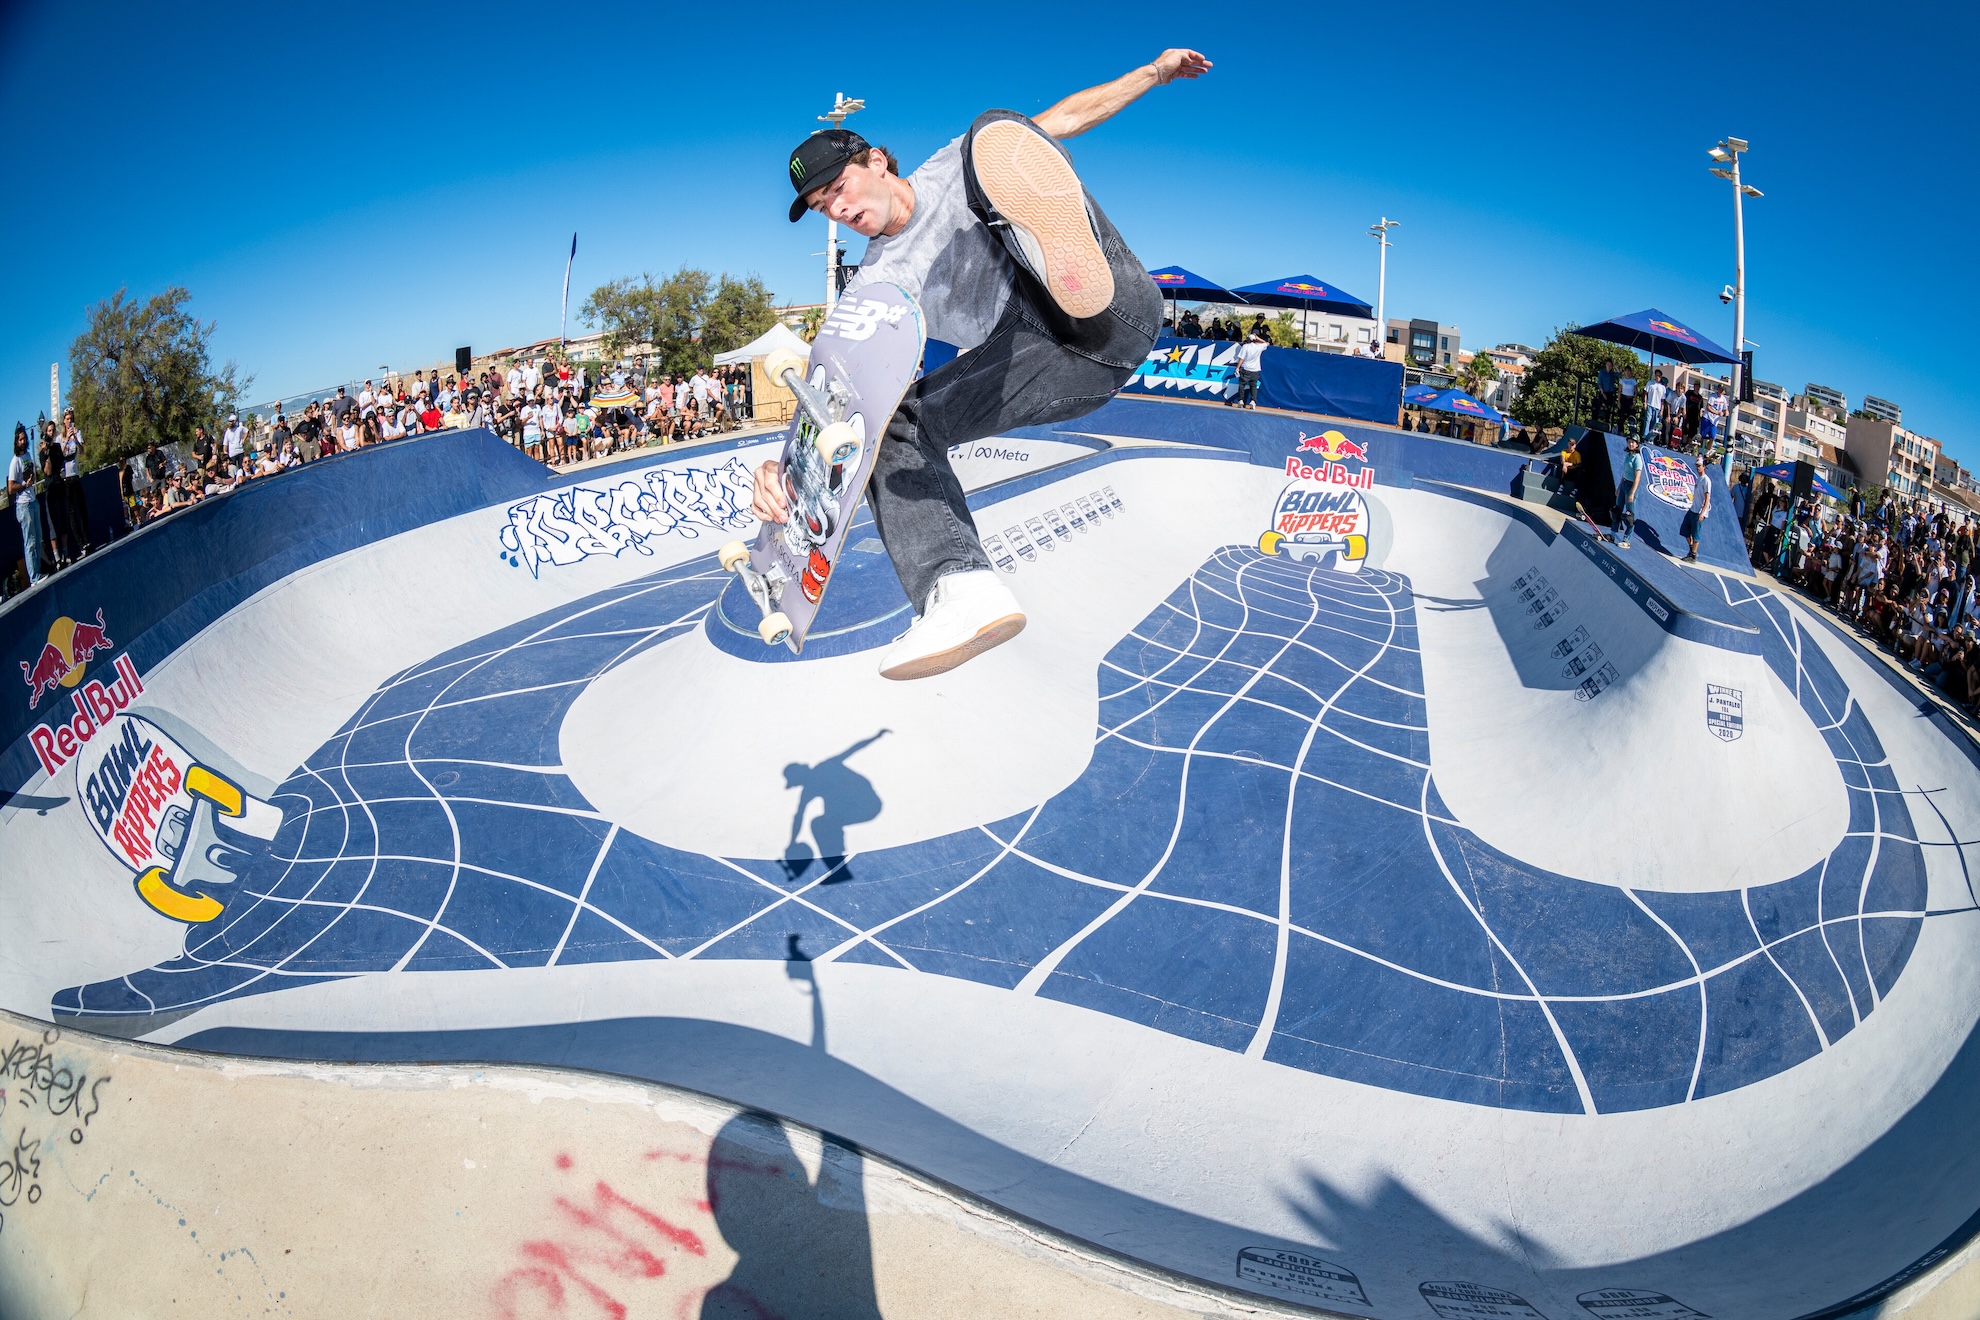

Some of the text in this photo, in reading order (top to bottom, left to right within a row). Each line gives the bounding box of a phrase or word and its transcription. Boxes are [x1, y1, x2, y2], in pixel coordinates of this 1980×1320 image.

[1277, 286, 1327, 297] Red Bull
[993, 448, 1029, 462] Meta
[1286, 455, 1375, 490] Red Bull
[1648, 463, 1695, 485] Red Bull
[1662, 477, 1685, 487] BOWL
[1279, 490, 1357, 514] BOWL
[28, 652, 145, 776] Red Bull
[1719, 729, 1733, 738] 2020
[86, 716, 153, 836] BOWL
[1256, 1256, 1340, 1280] Bowlriders
[1276, 1251, 1322, 1268] 2002
[1288, 1273, 1315, 1282] USA
